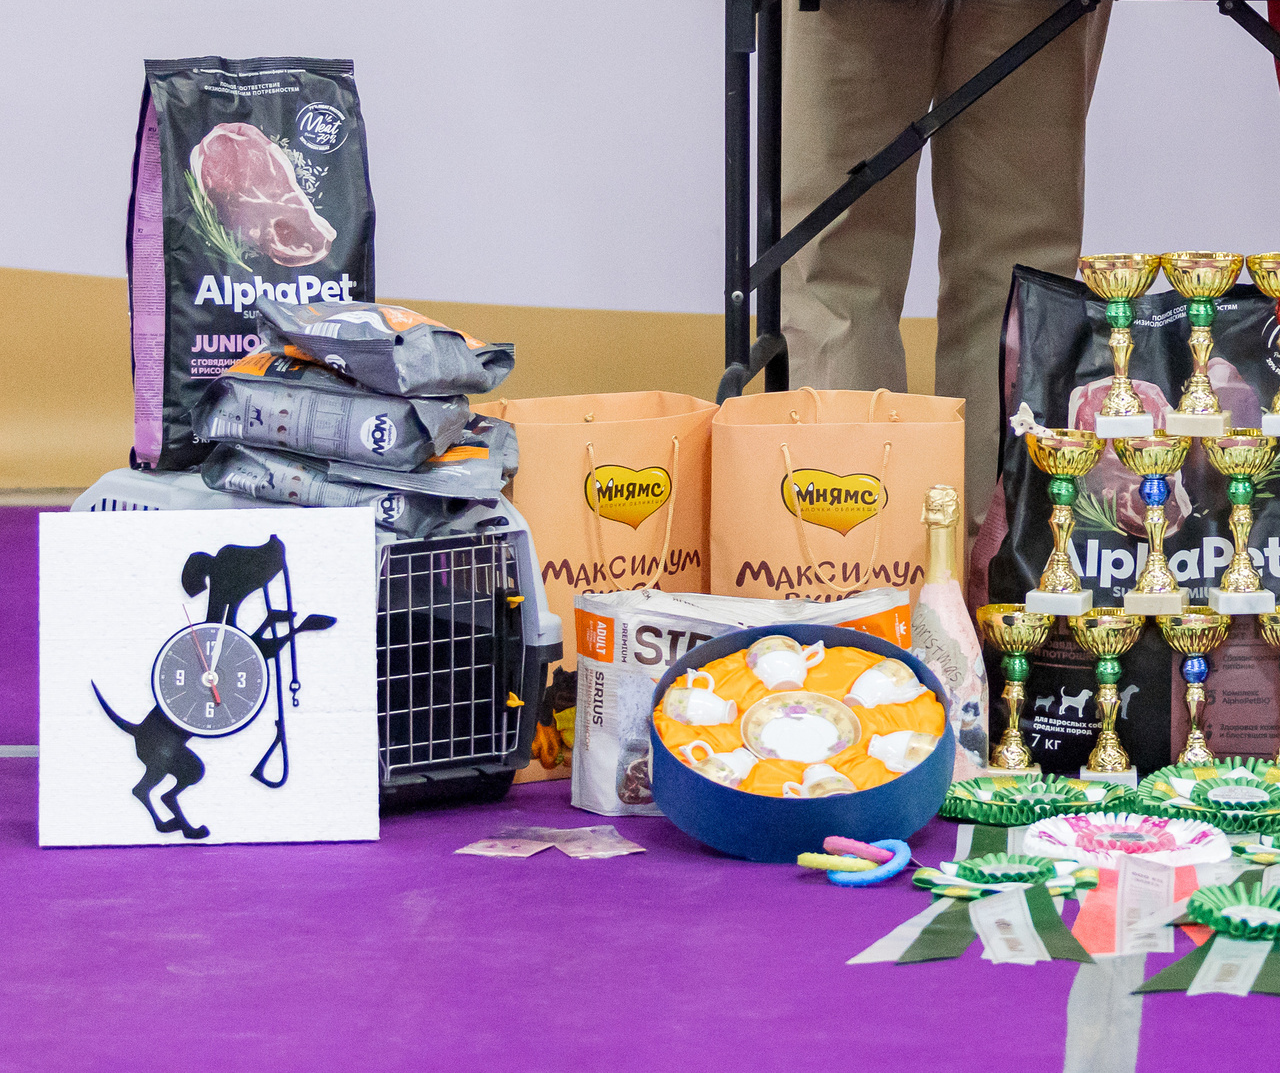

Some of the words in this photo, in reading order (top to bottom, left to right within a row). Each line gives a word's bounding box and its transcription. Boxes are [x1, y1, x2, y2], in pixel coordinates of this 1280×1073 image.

[300, 112, 342, 134] Meat
[194, 274, 353, 313] AlphaPet
[596, 621, 607, 655] ADULT
[621, 622, 629, 663] PREMIUM
[911, 614, 963, 683] Christmas
[176, 670, 185, 686] 9
[237, 672, 246, 688] 3
[592, 671, 605, 725] SIRIUS
[205, 702, 214, 718] 6
[1033, 723, 1064, 733] средних
[1048, 718, 1086, 728] взрослых
[1031, 734, 1041, 747] 7
